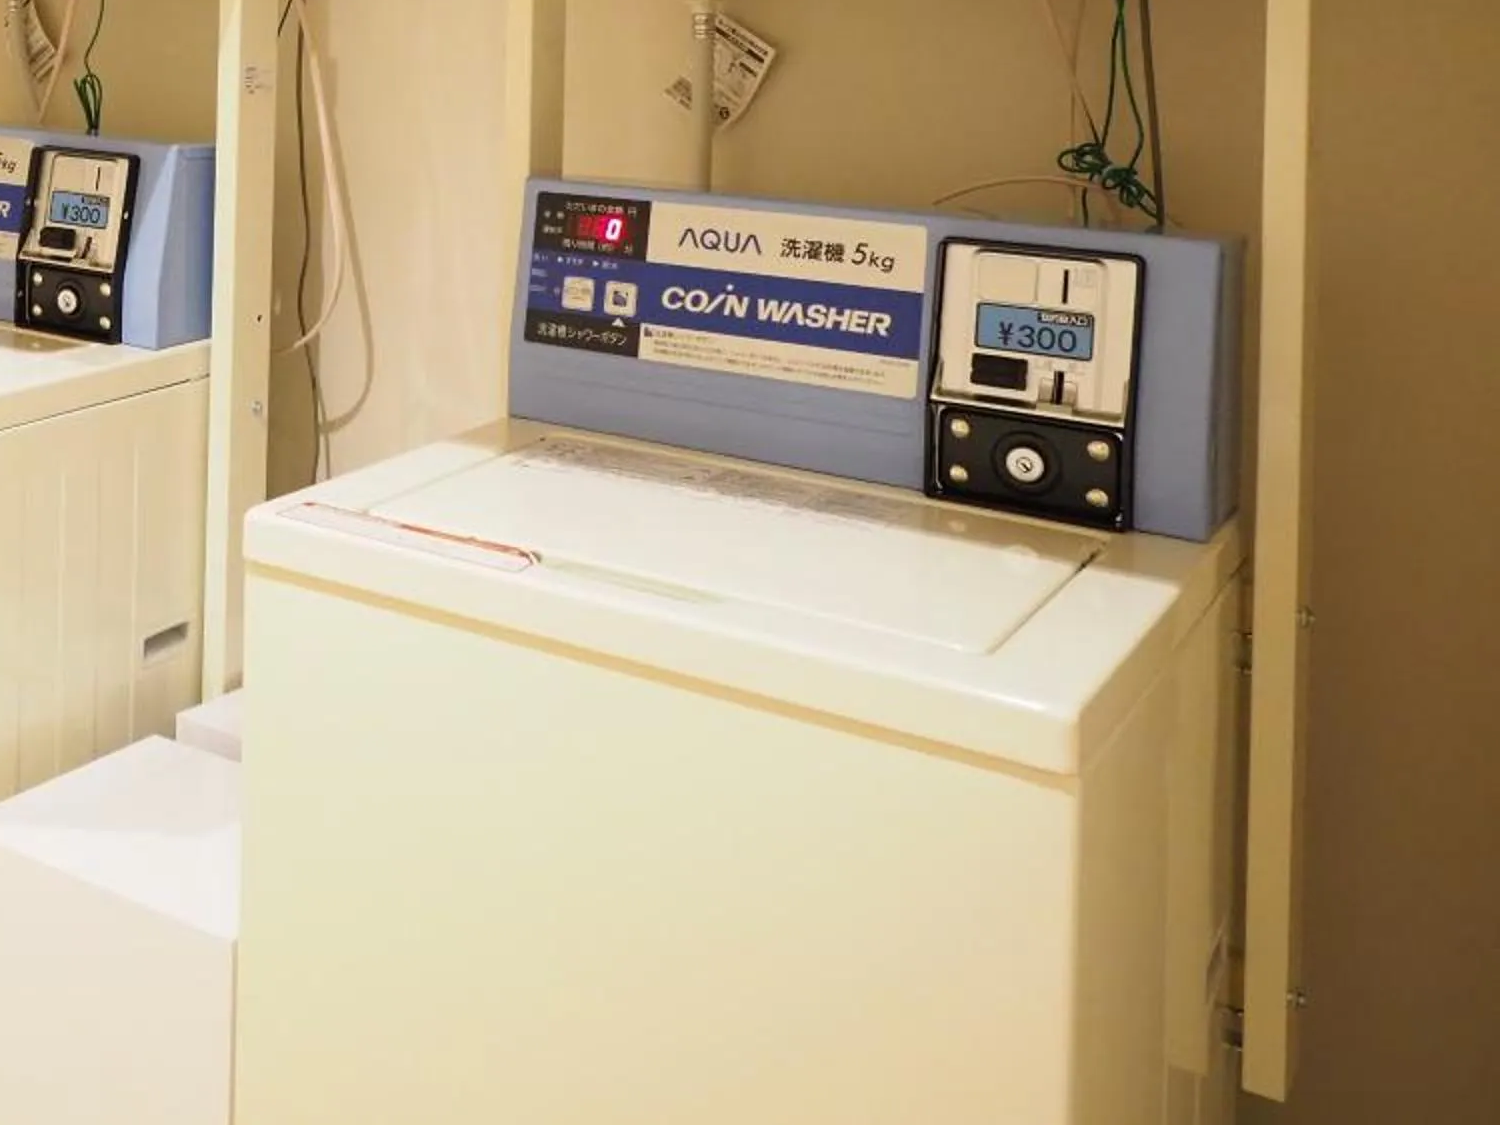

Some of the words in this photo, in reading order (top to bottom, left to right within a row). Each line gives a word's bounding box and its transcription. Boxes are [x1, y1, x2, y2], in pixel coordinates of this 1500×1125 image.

[605, 218, 622, 240] 0
[678, 228, 762, 256] AQUA
[780, 237, 845, 263] 洗濯機
[851, 243, 895, 273] 5kg
[757, 298, 892, 337] WASHER
[998, 321, 1077, 353] ¥300
